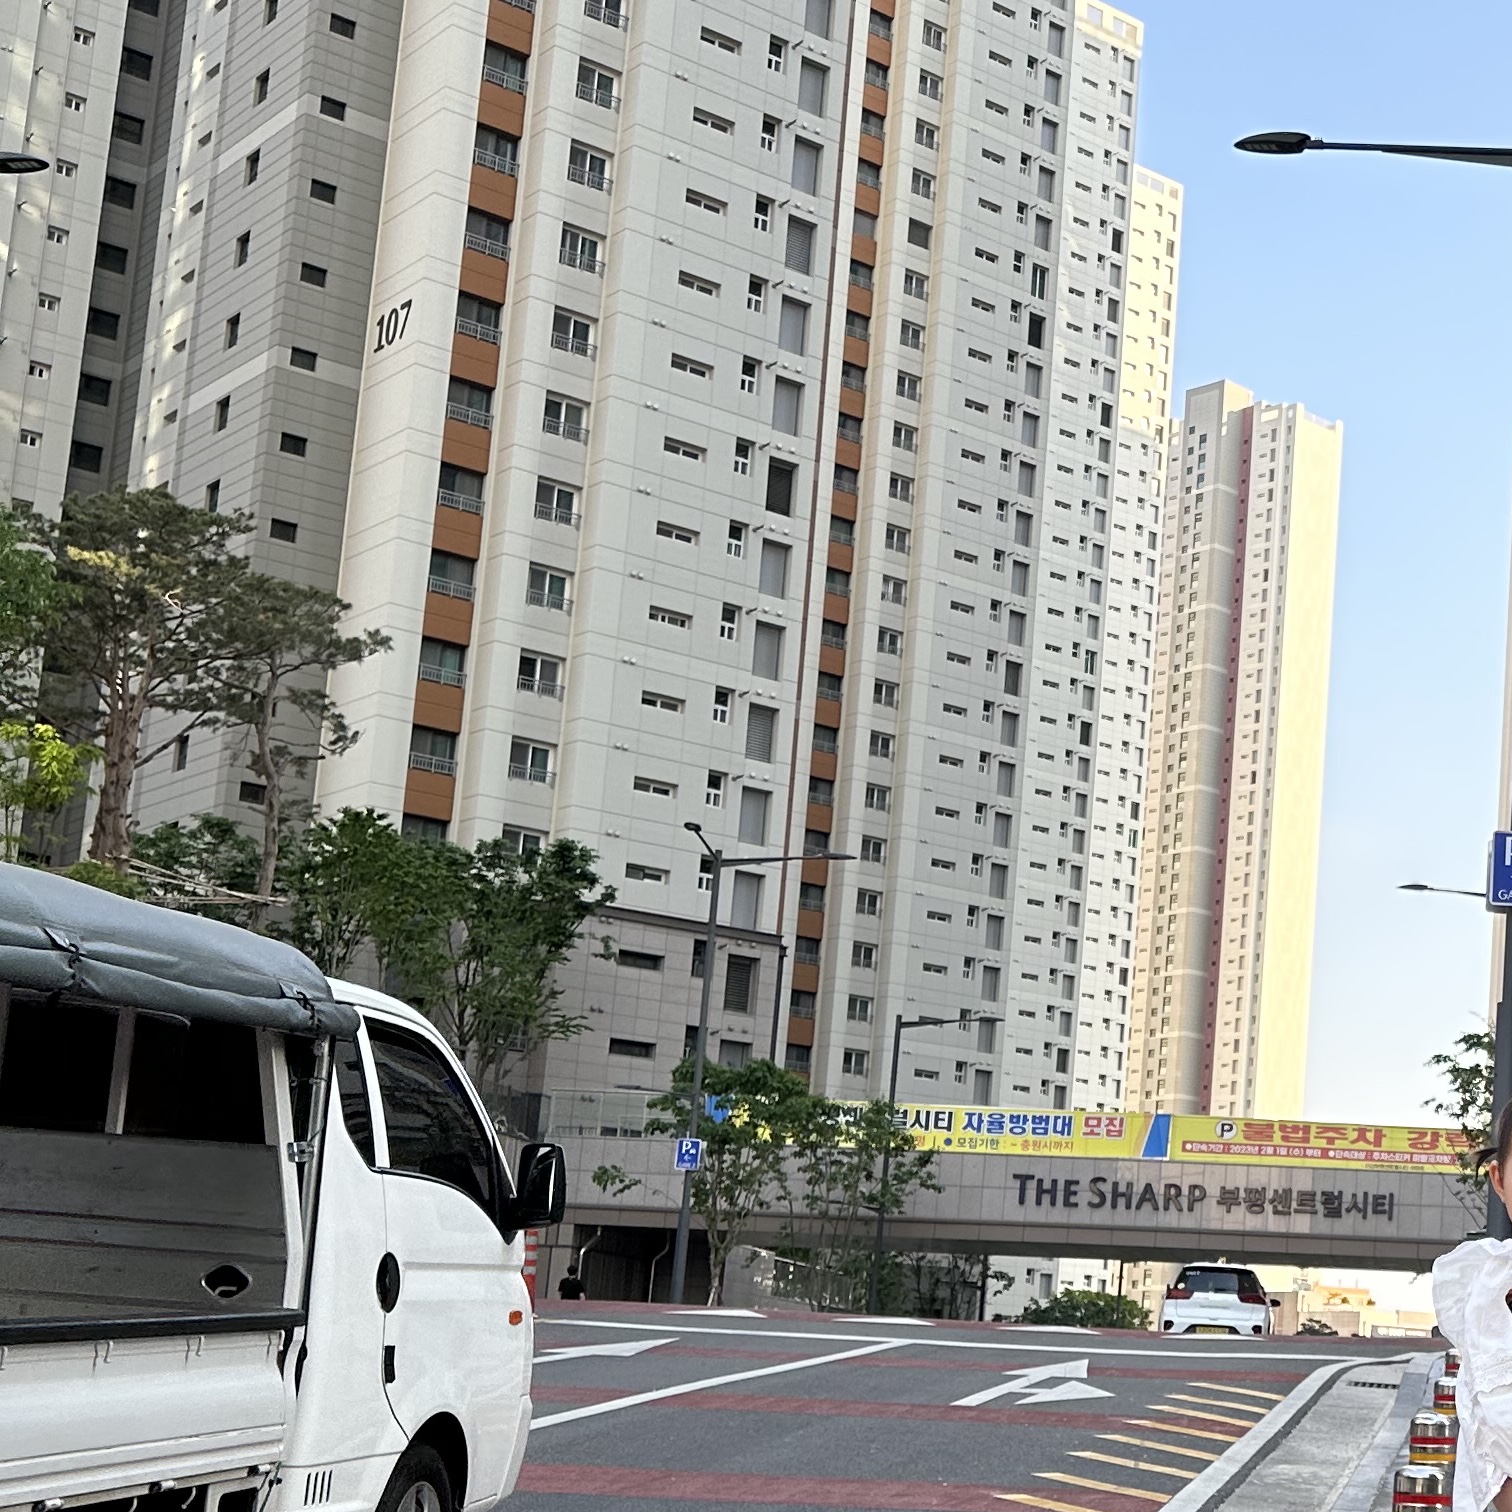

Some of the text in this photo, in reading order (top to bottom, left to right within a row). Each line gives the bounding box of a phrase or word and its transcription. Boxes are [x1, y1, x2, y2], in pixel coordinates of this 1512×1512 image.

[373, 299, 413, 353] 107
[962, 1111, 1074, 1137] 자율방범대
[1082, 1115, 1126, 1139] 모집
[1241, 1121, 1387, 1149] 불법주차
[681, 1140, 692, 1154] P
[957, 1136, 1000, 1150] 모집기한
[1230, 1144, 1259, 1155] 2023년
[1012, 1173, 1395, 1221] THE SHARP 부평센트럴시티
